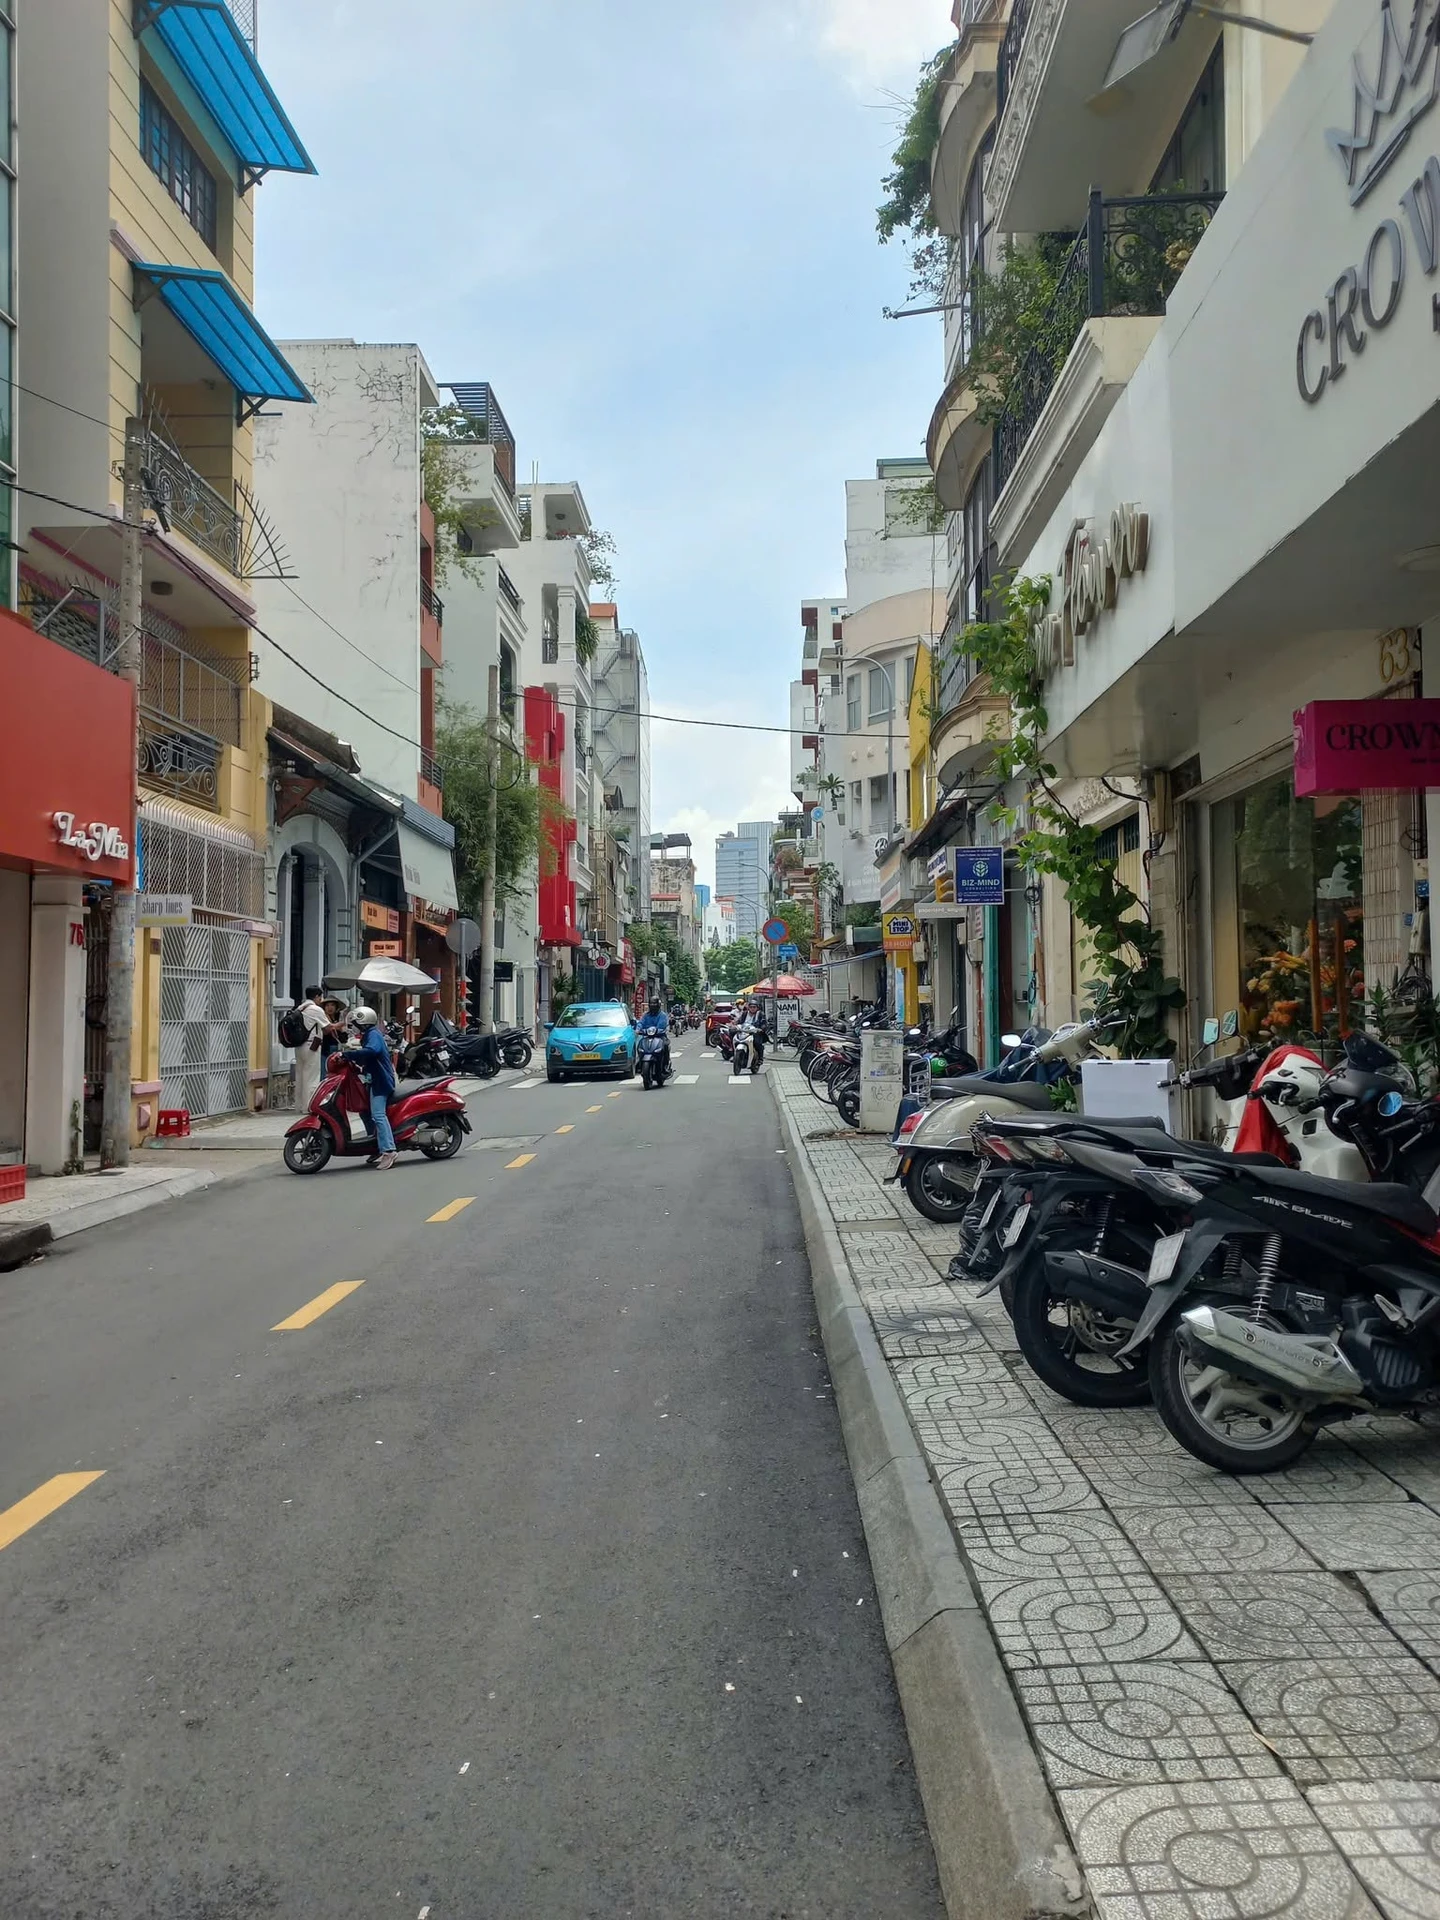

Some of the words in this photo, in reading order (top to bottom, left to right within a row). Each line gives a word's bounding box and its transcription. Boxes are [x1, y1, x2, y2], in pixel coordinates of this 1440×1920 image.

[1379, 627, 1410, 683] 63
[962, 878, 1000, 887] BIZ-MIND
[141, 897, 163, 916] sharp
[1252, 1196, 1290, 1210] AIR
[1291, 1204, 1353, 1229] BLADE
